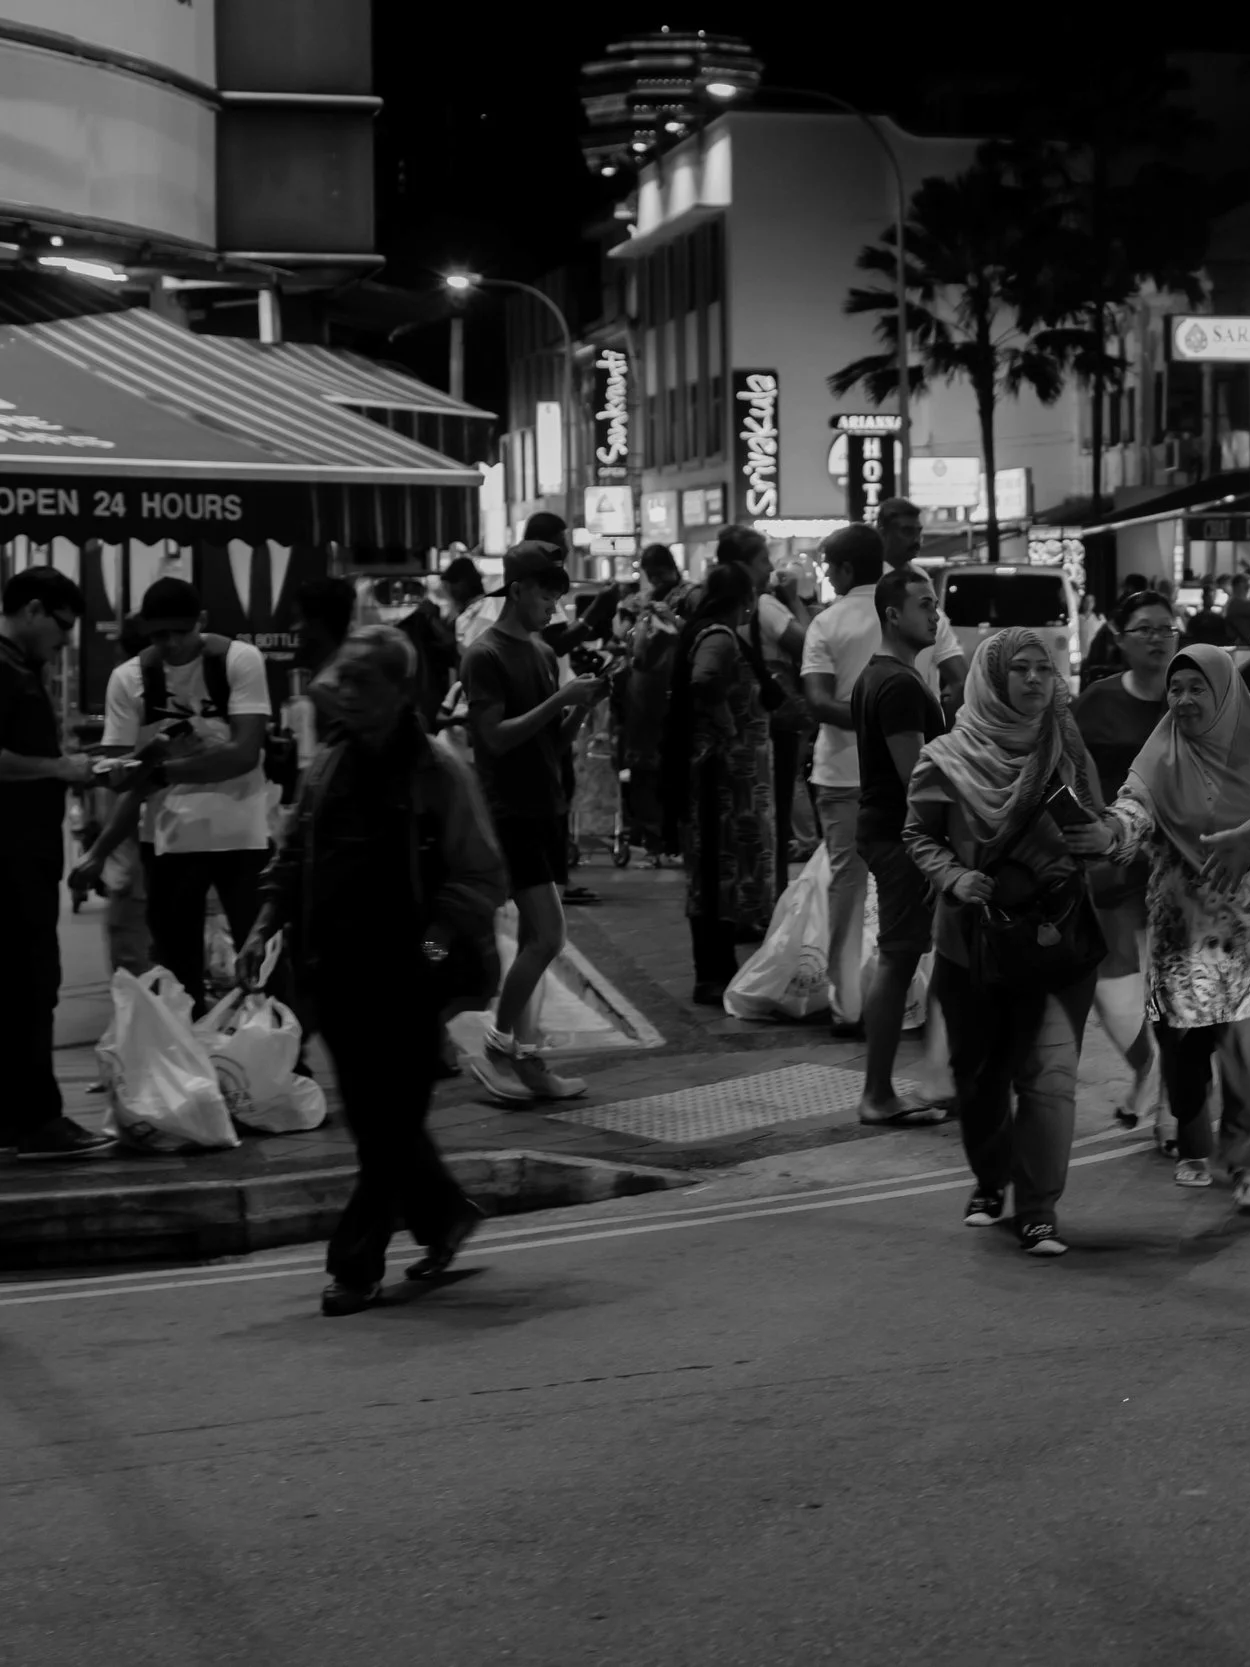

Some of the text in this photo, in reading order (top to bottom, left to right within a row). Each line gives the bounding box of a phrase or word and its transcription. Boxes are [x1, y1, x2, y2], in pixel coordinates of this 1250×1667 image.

[0, 486, 243, 521] OPEN 24 HOURS
